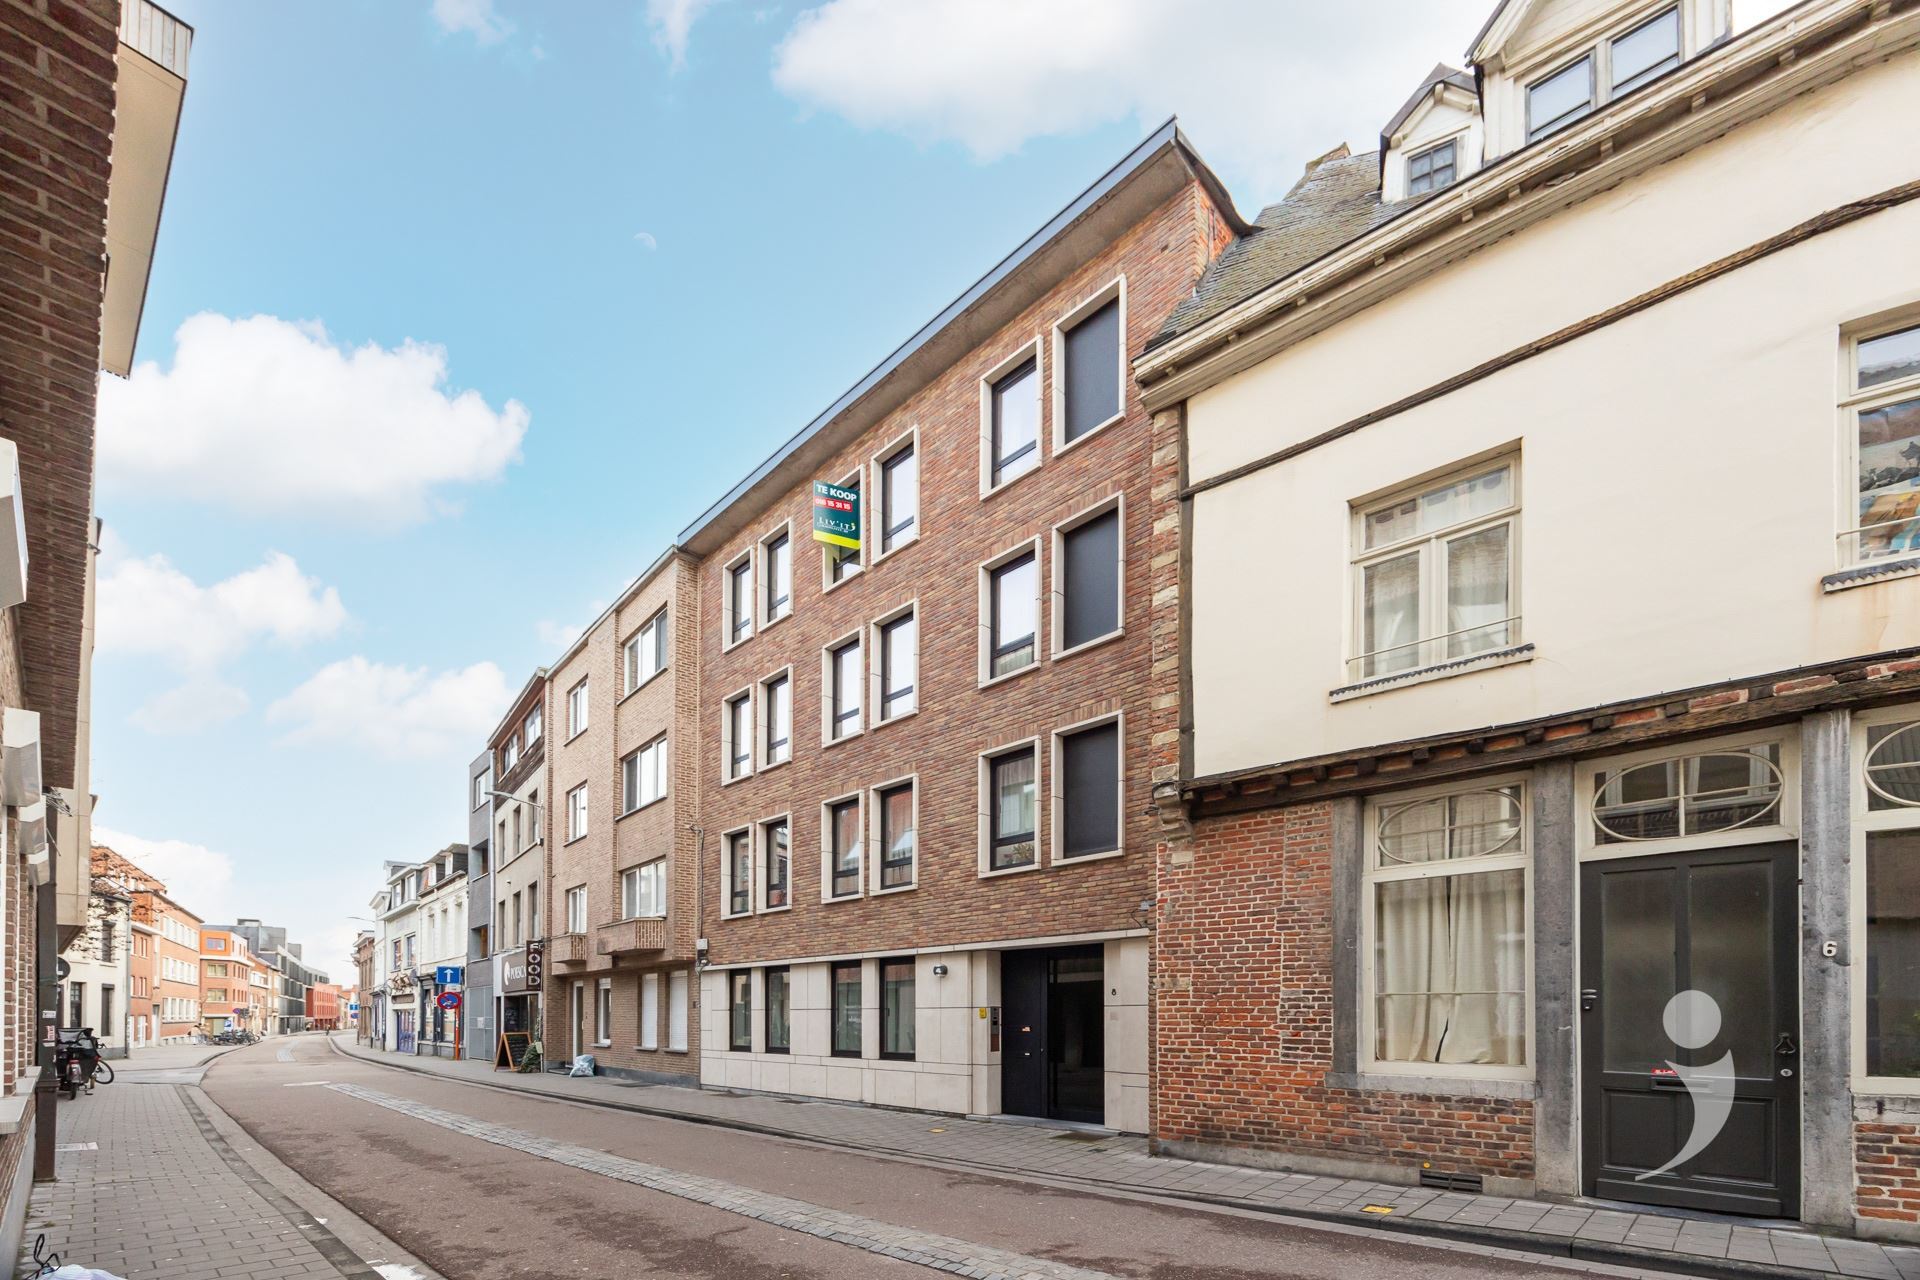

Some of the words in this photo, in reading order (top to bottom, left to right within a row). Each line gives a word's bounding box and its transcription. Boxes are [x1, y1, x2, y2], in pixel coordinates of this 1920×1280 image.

[816, 483, 828, 495] TE
[830, 488, 857, 501] KOOP
[1822, 941, 1838, 957] 6
[528, 942, 541, 985] FOOD
